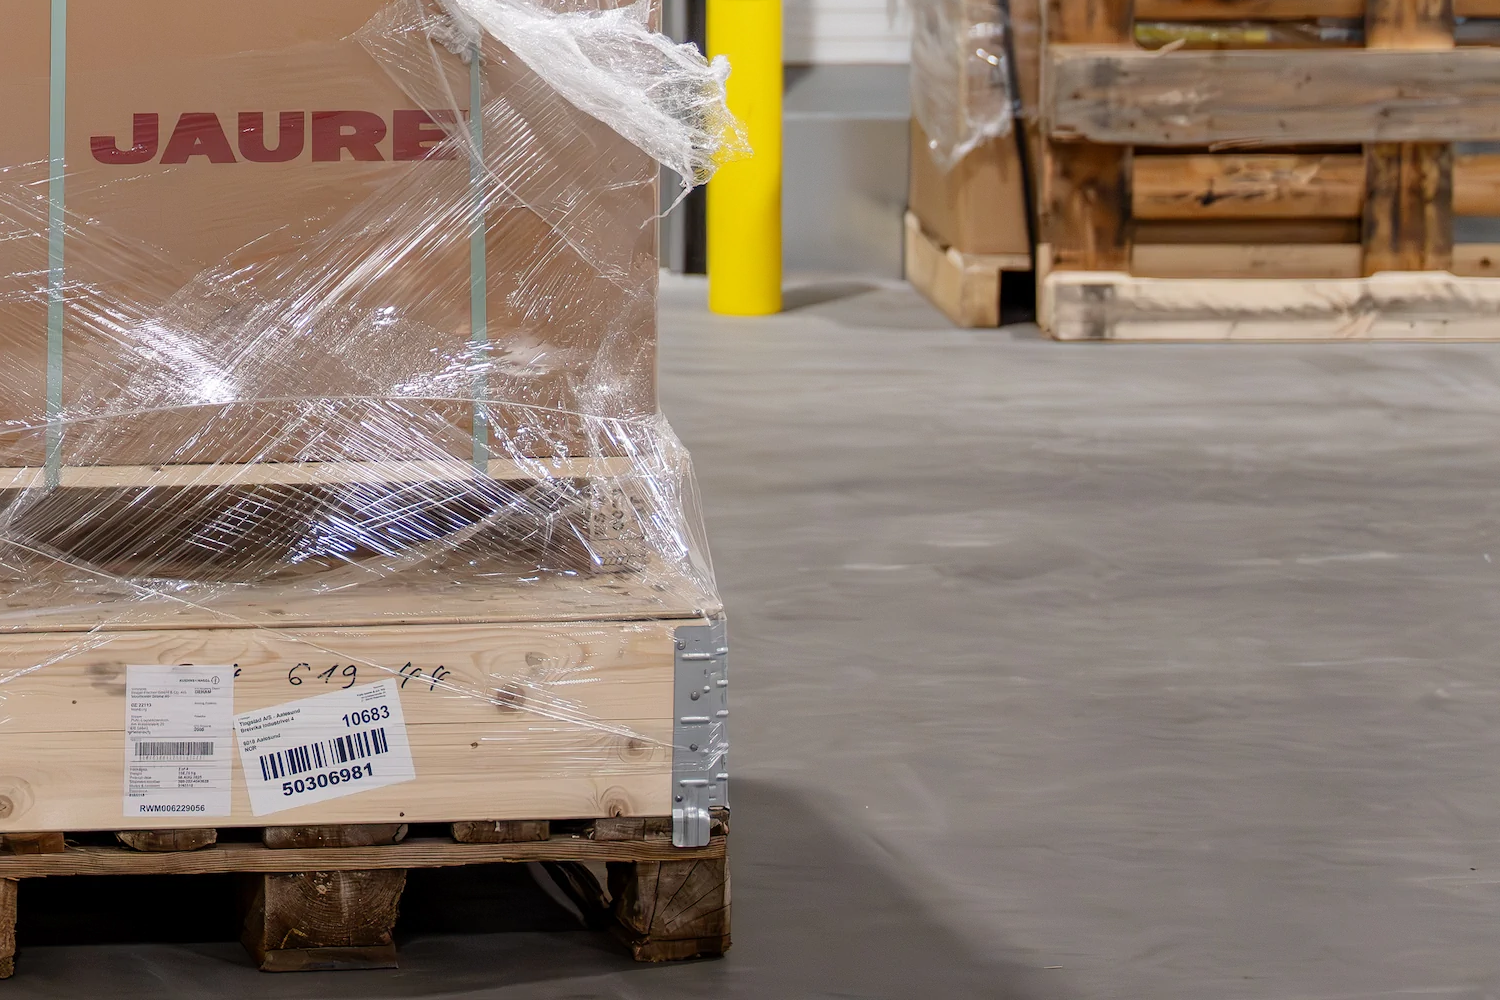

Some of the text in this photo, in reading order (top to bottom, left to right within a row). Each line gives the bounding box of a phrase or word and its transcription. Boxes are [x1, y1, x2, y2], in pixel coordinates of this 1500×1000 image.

[90, 109, 457, 165] JAURE
[341, 705, 390, 728] 10683
[282, 762, 373, 796] 50306981
[139, 804, 206, 813] RWM006229056
